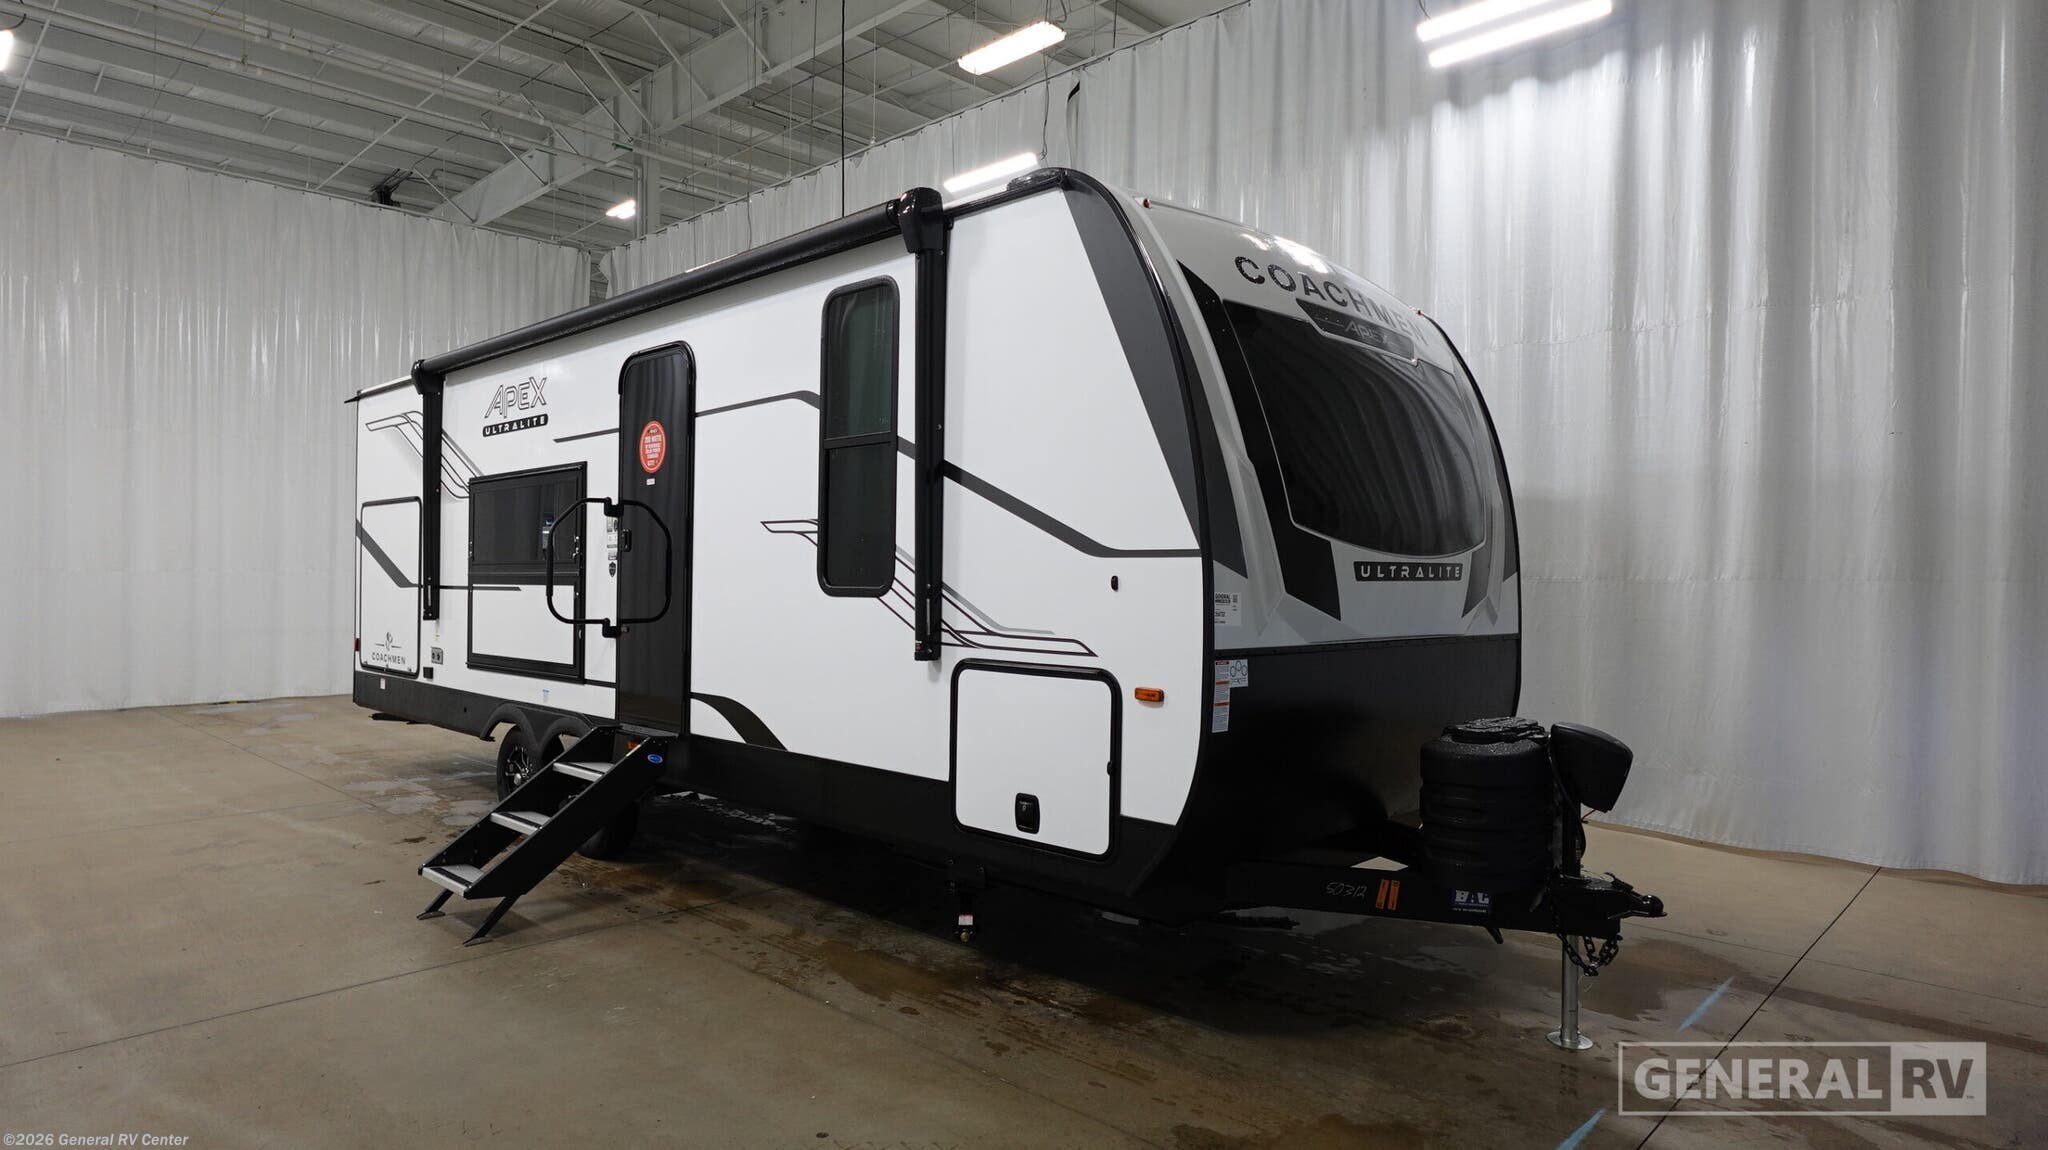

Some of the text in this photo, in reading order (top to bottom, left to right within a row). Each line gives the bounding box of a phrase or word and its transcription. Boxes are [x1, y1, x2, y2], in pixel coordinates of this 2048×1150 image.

[1234, 255, 1429, 346] COACHMEN
[484, 376, 548, 419] APEX
[484, 415, 546, 436] ULTRALITE
[1360, 565, 1461, 578] ULTRALITE
[371, 651, 406, 665] COACHMEN
